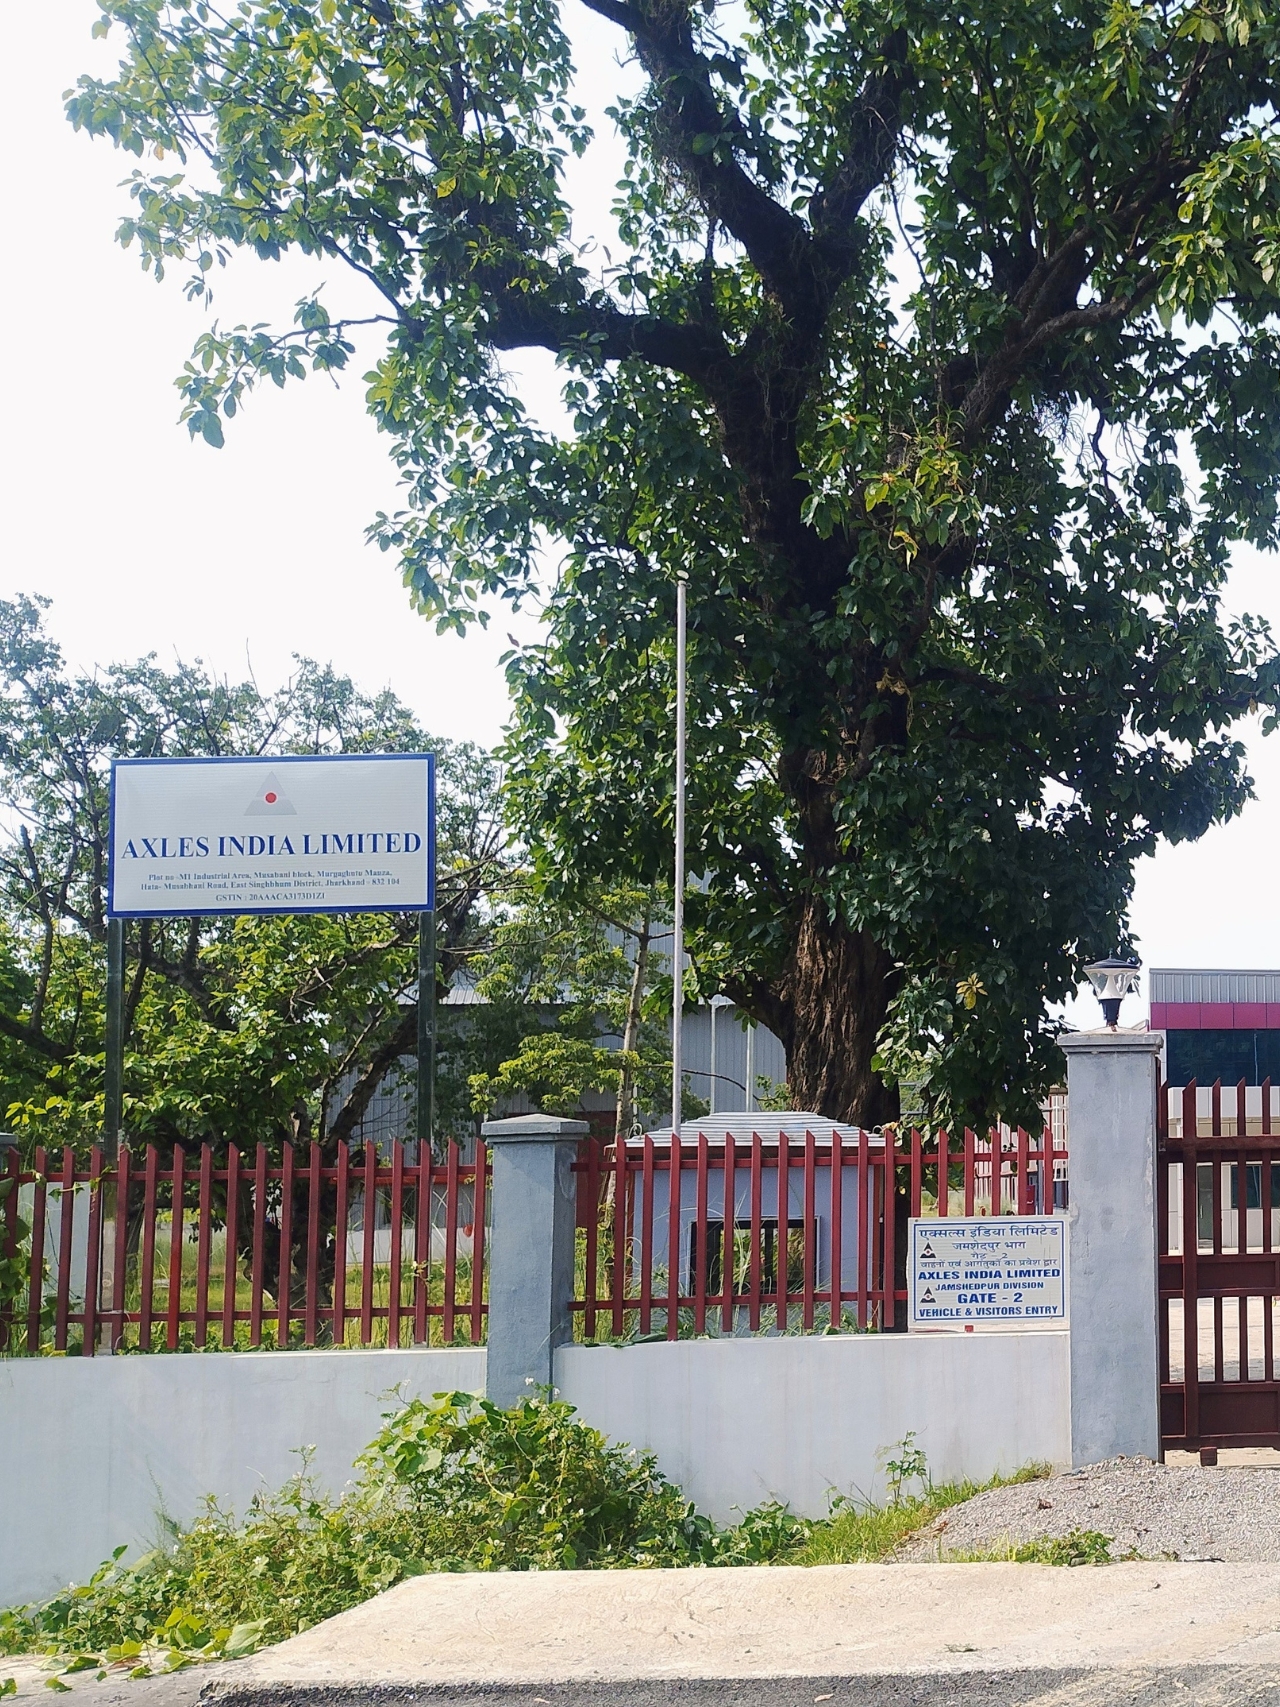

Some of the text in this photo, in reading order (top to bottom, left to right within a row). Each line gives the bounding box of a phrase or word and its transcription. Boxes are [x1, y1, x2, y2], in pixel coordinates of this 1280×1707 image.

[122, 832, 422, 859] AXLES INDIA LIMITED
[249, 880, 292, 889] Singhbhum
[325, 878, 366, 886] Jharkhand
[216, 894, 242, 902] GSTIN
[919, 1224, 1060, 1240] एक्सल्स इंडिया लिमिटेड
[952, 1240, 1026, 1252] जमशेदपुर भाग
[918, 1268, 1060, 1280] AXLES INDIA LIMITED
[935, 1282, 1044, 1292] JAMSHEDPUR DIVISION
[957, 1292, 997, 1304] GATE
[1013, 1292, 1024, 1303] 2
[919, 1306, 1058, 1318] VEHICLE & VISITORS ENTRY
